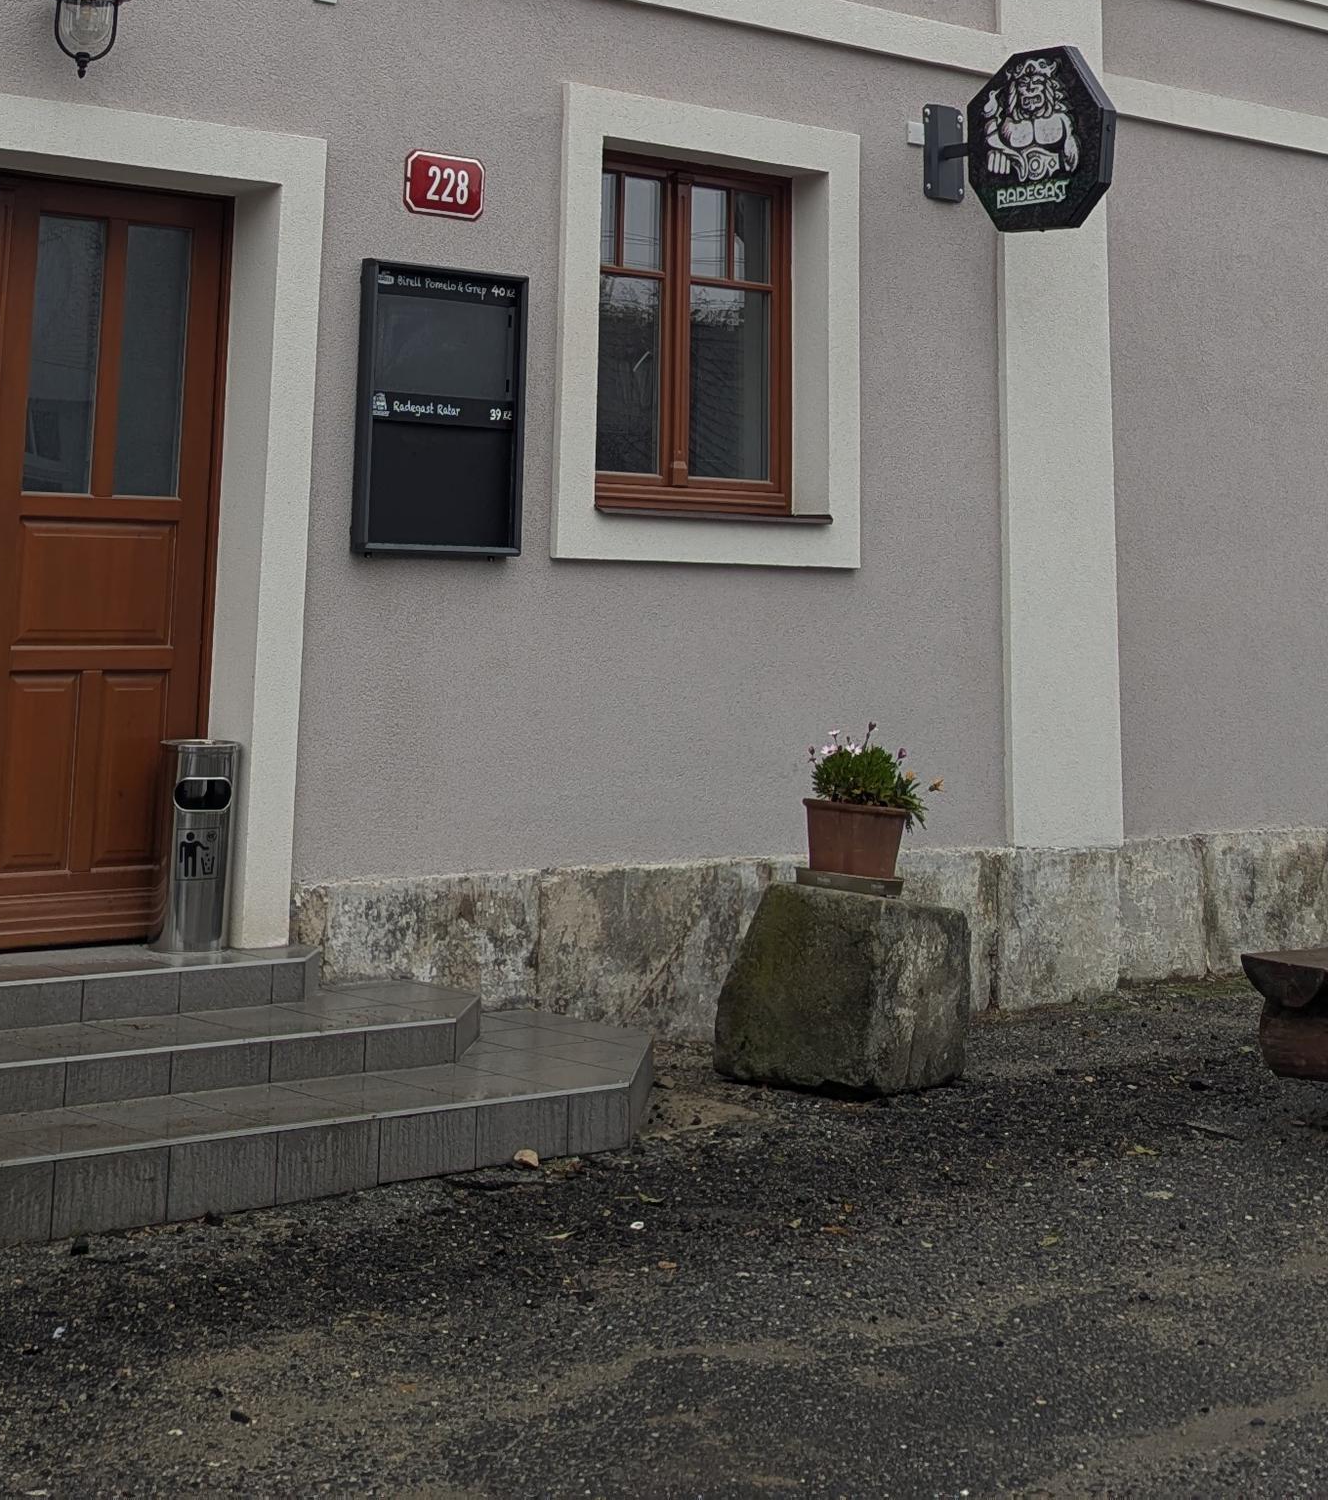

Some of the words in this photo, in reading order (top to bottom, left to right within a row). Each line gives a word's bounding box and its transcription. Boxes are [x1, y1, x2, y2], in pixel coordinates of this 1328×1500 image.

[426, 165, 469, 205] 228
[996, 179, 1070, 209] RADEGAST
[465, 283, 487, 300] Grep
[491, 285, 506, 298] 40
[393, 400, 434, 417] Radegast
[436, 403, 461, 417] Ratar
[489, 408, 502, 420] 39
